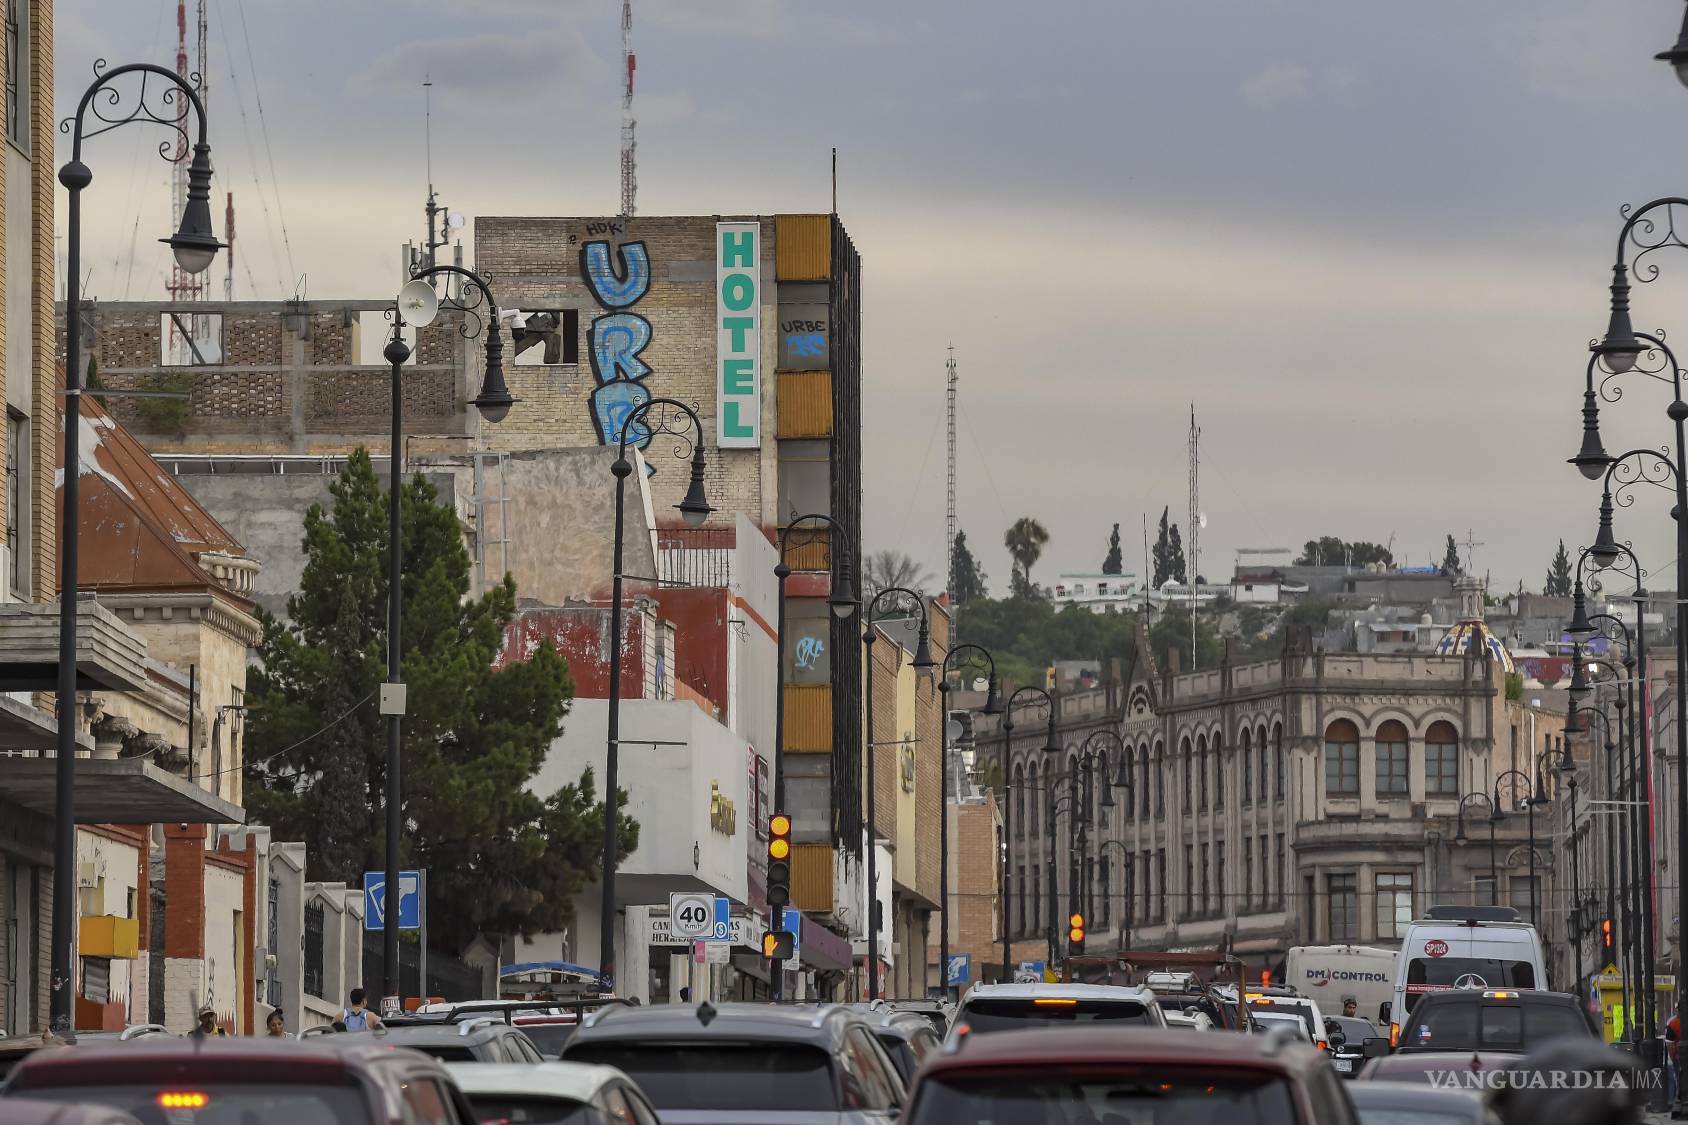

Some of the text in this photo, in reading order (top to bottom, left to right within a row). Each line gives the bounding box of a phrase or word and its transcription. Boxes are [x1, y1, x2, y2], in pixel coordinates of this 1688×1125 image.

[781, 320, 826, 333] URBE
[722, 231, 754, 438] HOTEL
[580, 239, 656, 478] URB
[680, 906, 707, 923] 40
[652, 921, 670, 931] CAN
[1306, 969, 1389, 982] DM CONTROL
